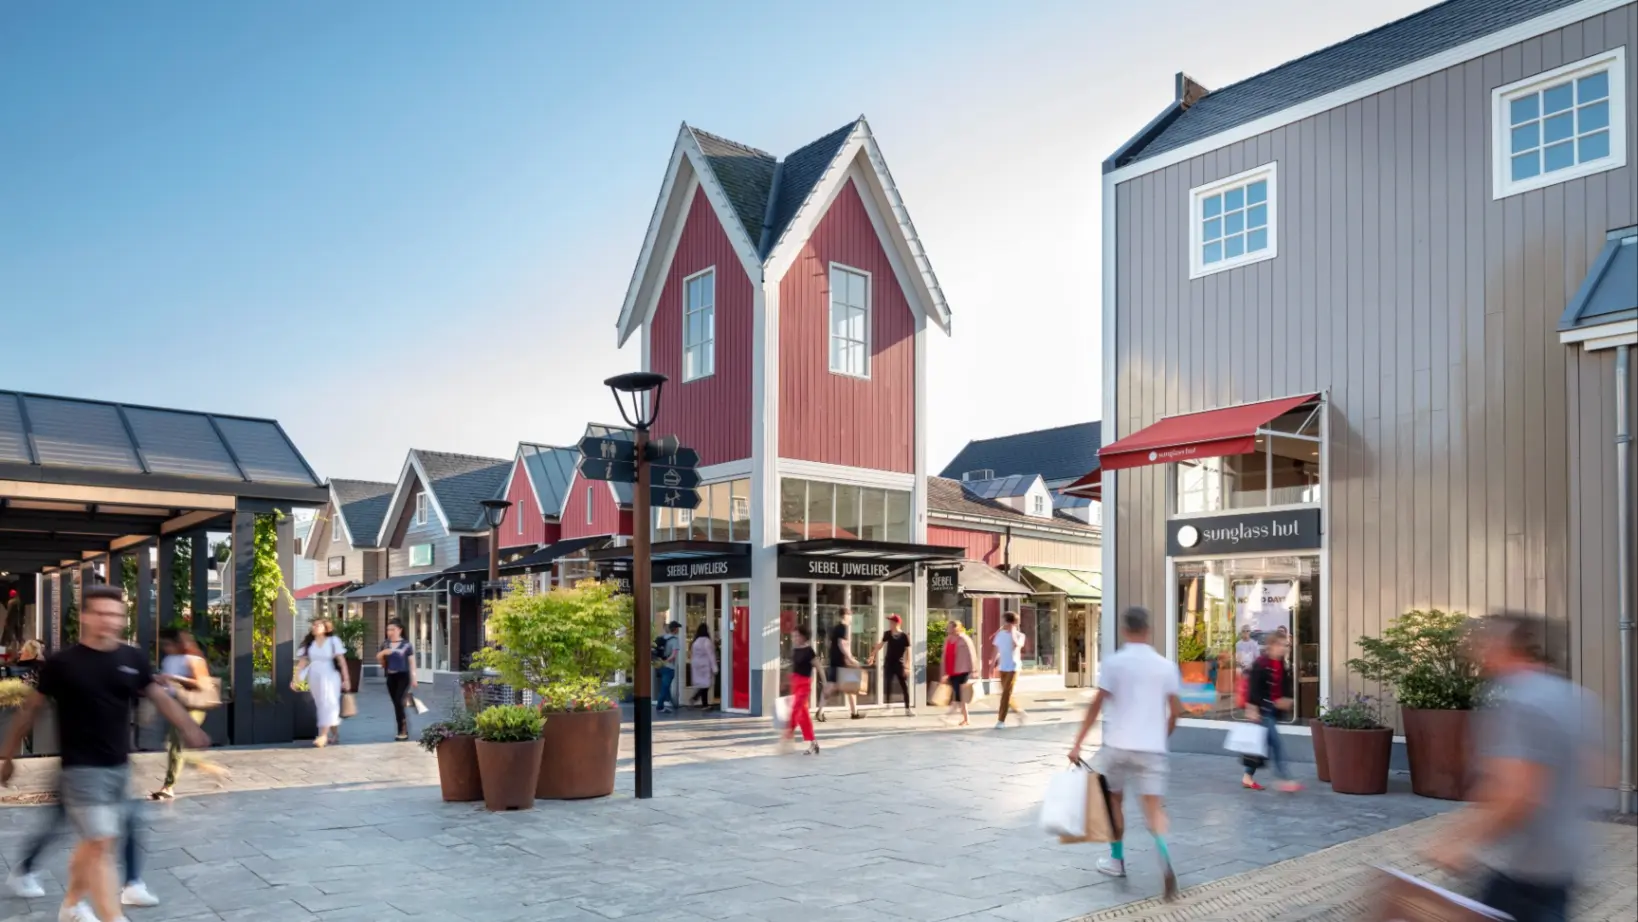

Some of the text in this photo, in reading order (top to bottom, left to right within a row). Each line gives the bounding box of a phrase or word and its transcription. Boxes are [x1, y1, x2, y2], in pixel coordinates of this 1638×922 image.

[1203, 519, 1299, 544] sunglass hut
[666, 561, 728, 579] SIEBEL JUWELIERS
[808, 560, 890, 578] SIEBEL JUWELIERS
[931, 575, 953, 587] SIEBEL
